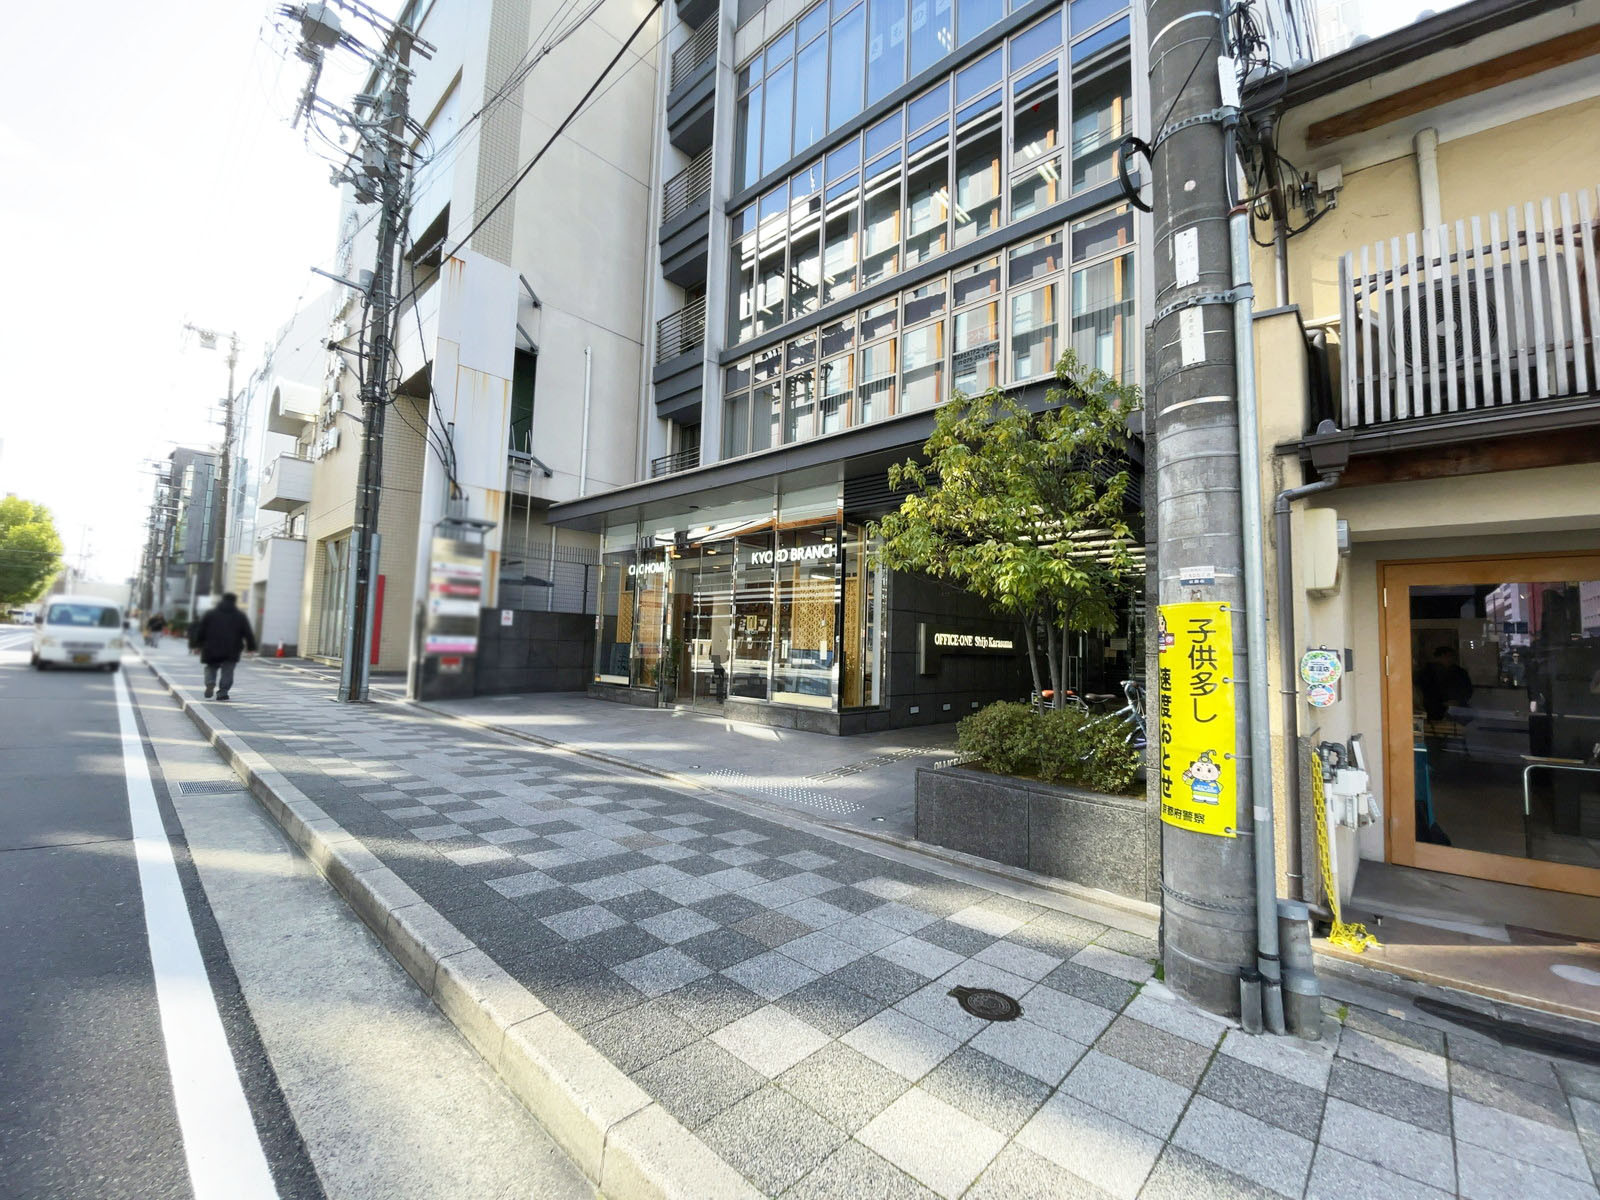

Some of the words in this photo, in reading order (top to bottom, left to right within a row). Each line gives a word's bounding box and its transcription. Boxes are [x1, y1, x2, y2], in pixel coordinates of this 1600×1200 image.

[791, 543, 838, 561] BRANCH
[974, 635, 988, 649] Shijo
[1187, 618, 1218, 723] 子供多し
